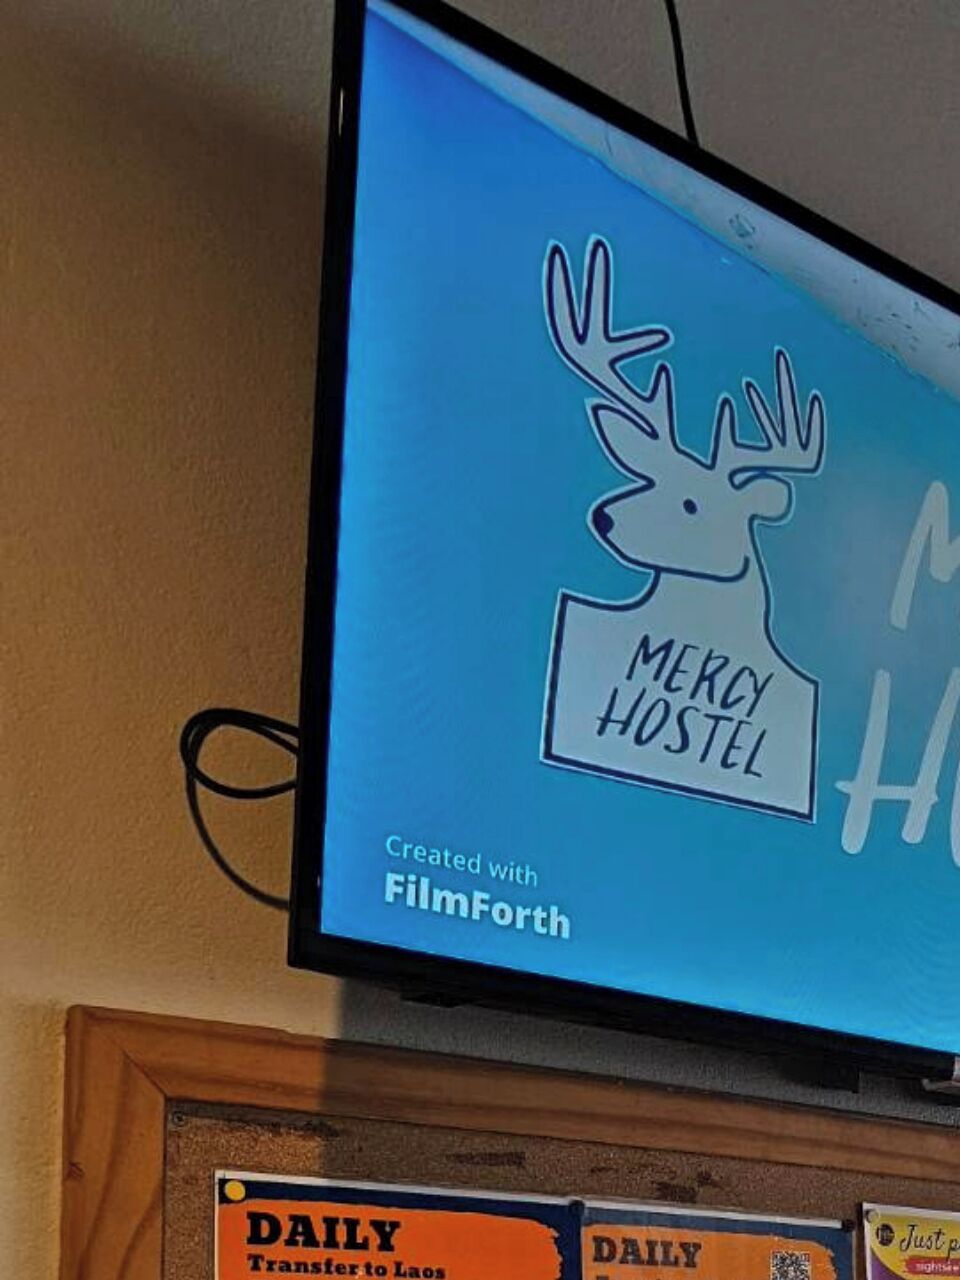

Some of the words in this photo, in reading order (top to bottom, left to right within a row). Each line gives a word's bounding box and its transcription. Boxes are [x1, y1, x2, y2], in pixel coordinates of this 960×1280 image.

[626, 633, 774, 718] MERCY
[596, 687, 766, 778] HOSTEL
[385, 835, 482, 874] Created
[488, 861, 537, 887] with
[384, 871, 570, 939] FilmForth
[246, 1211, 401, 1252] DAILY
[591, 1234, 702, 1269] DAILY
[901, 1224, 946, 1252] Just
[247, 1253, 359, 1277] Transfer
[364, 1260, 388, 1278] to
[393, 1261, 446, 1280] Laos
